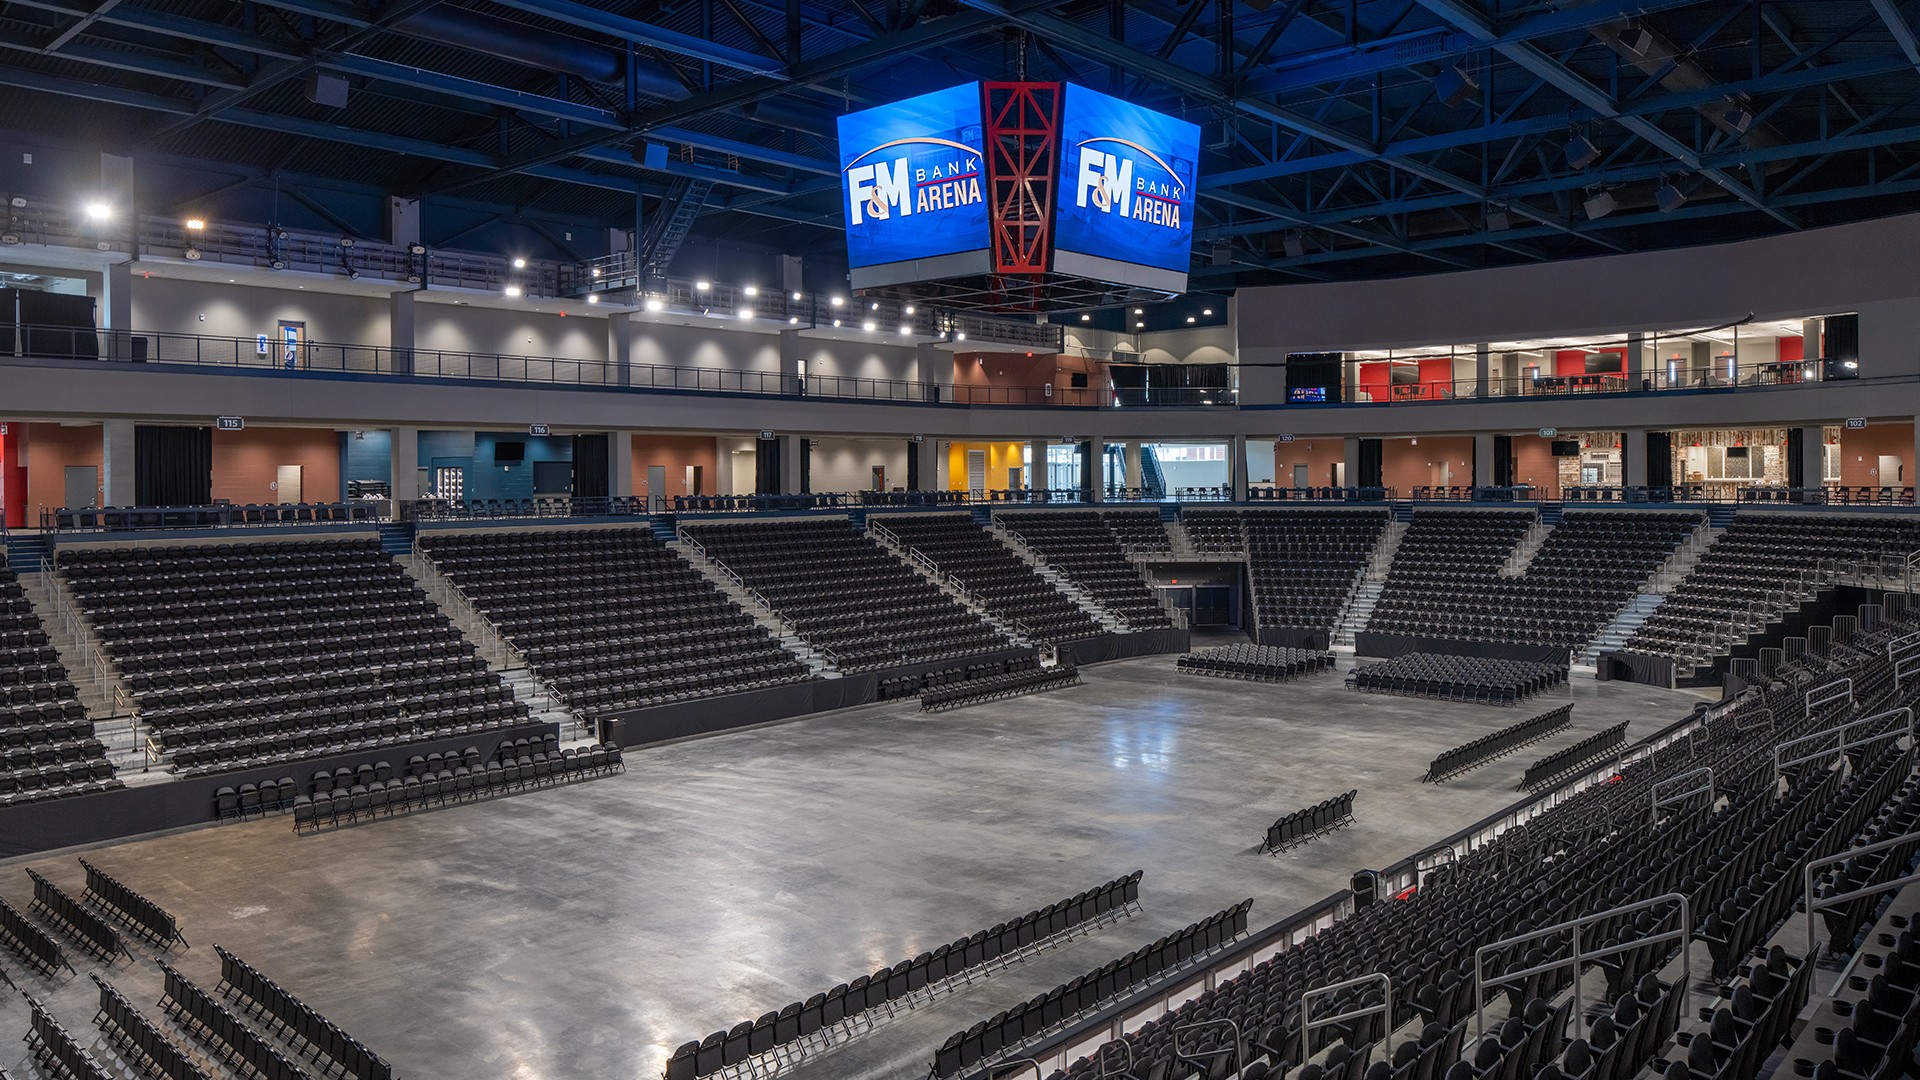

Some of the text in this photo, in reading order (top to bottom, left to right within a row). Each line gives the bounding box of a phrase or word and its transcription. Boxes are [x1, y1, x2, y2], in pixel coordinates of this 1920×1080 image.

[916, 157, 977, 182] BANK
[1077, 146, 1133, 217] F&M
[848, 157, 912, 225] F&M
[916, 178, 982, 214] ARENA
[1137, 177, 1181, 199] BANK
[1133, 196, 1180, 229] ARENA
[223, 419, 238, 427] 115
[534, 426, 546, 434] 116
